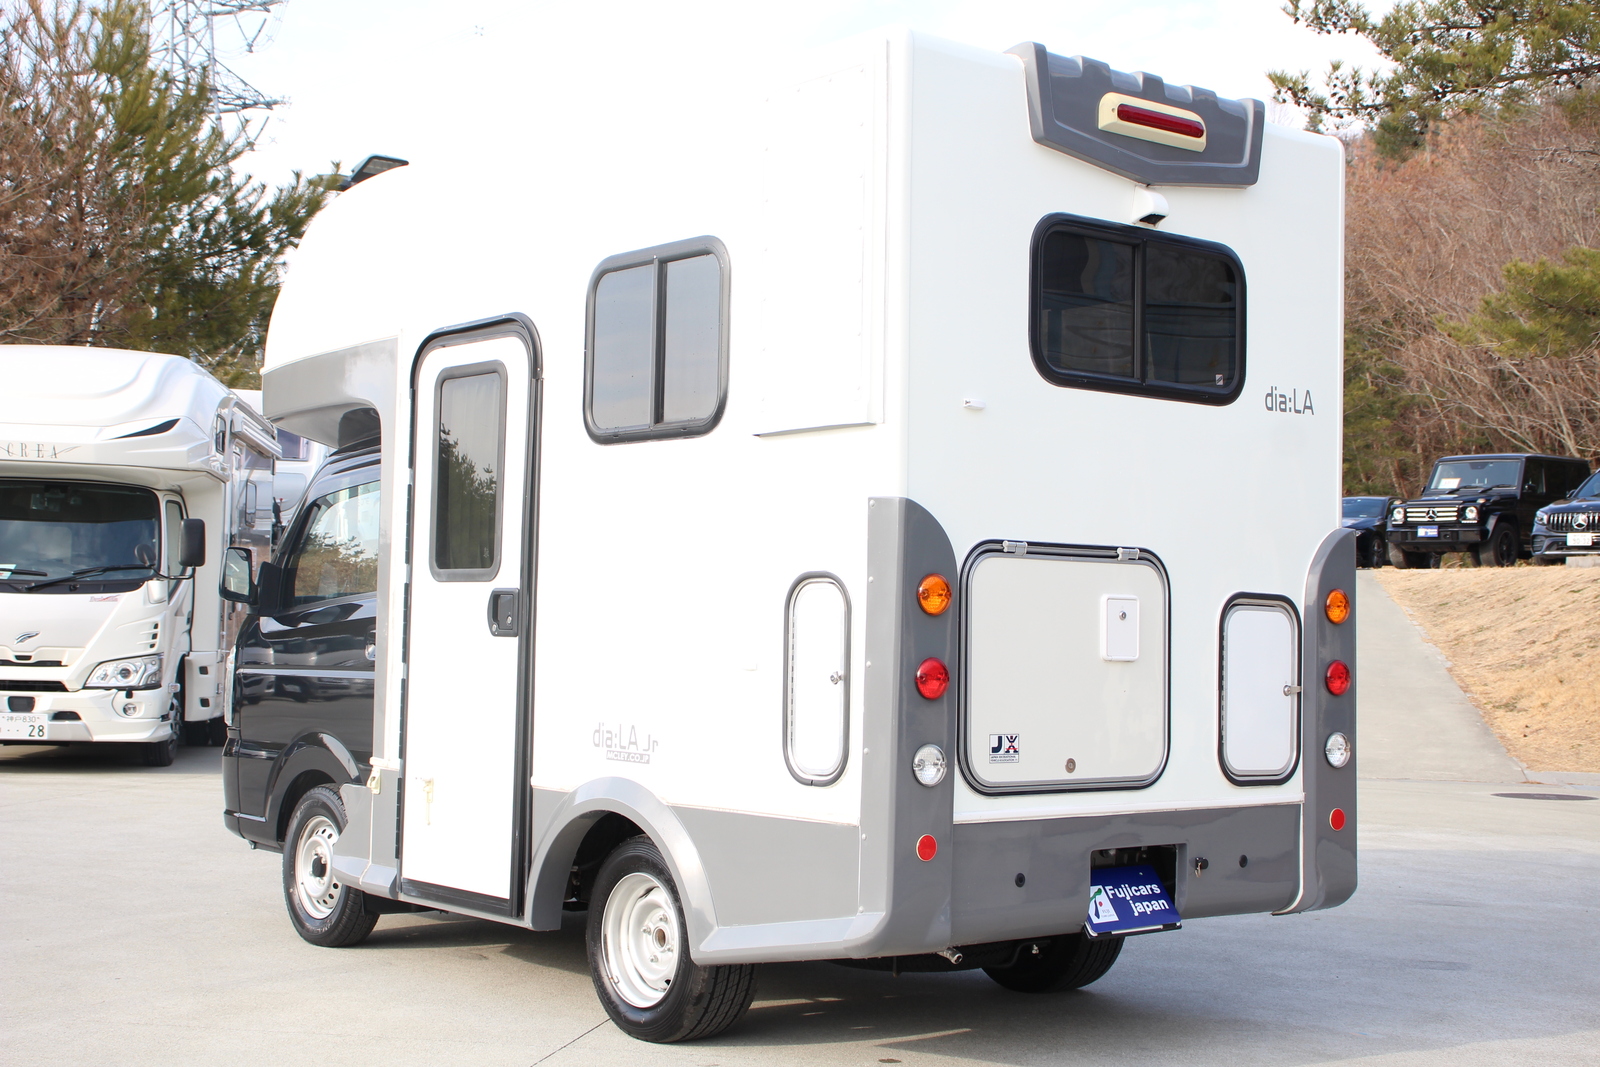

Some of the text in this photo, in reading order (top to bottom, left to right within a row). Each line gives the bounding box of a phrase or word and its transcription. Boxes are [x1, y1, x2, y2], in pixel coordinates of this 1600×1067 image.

[1265, 385, 1315, 415] dia:LA
[7, 442, 58, 459] CREA
[593, 722, 659, 753] dia:LA Jr
[1104, 884, 1161, 900] Fujicars
[1128, 899, 1170, 917] japan
